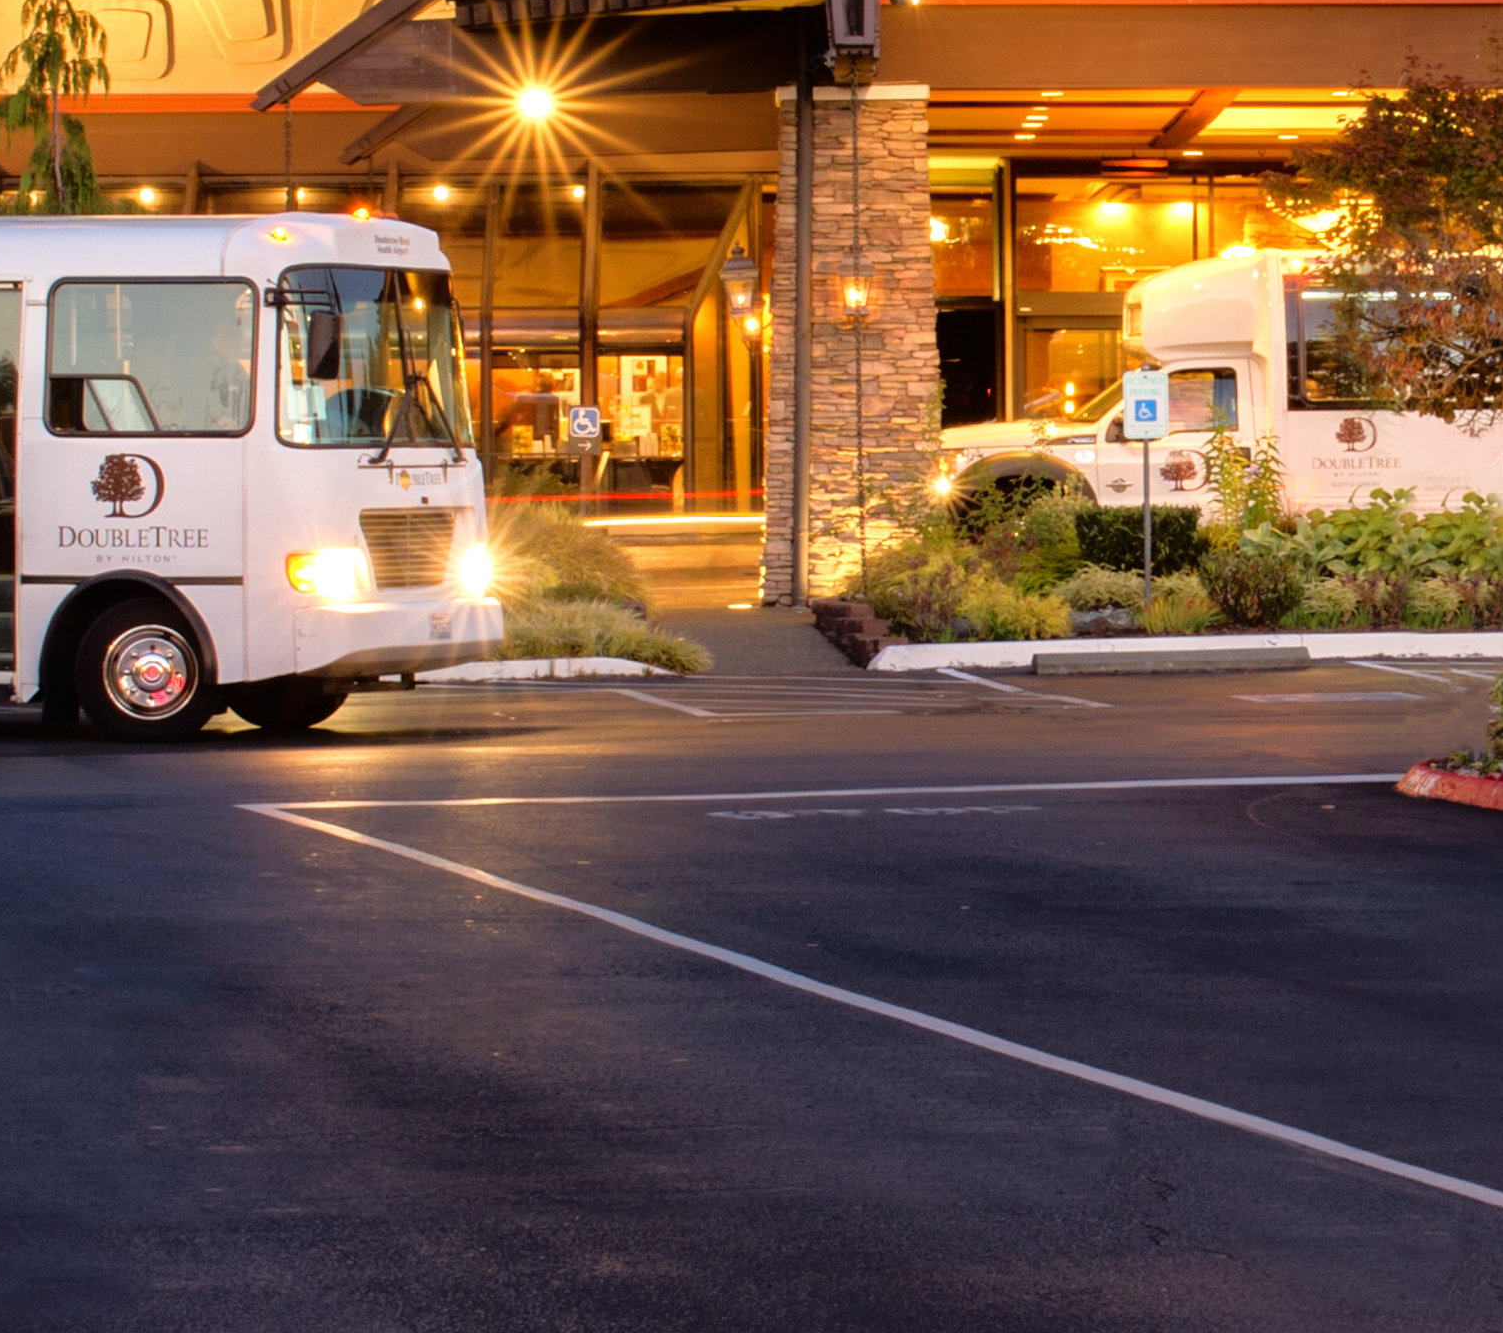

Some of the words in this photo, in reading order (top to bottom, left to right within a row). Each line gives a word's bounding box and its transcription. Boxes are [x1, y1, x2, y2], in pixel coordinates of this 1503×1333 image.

[1312, 456, 1402, 470] DOUBLETREE
[58, 526, 209, 548] DOUBLETREE
[96, 555, 113, 563] BY
